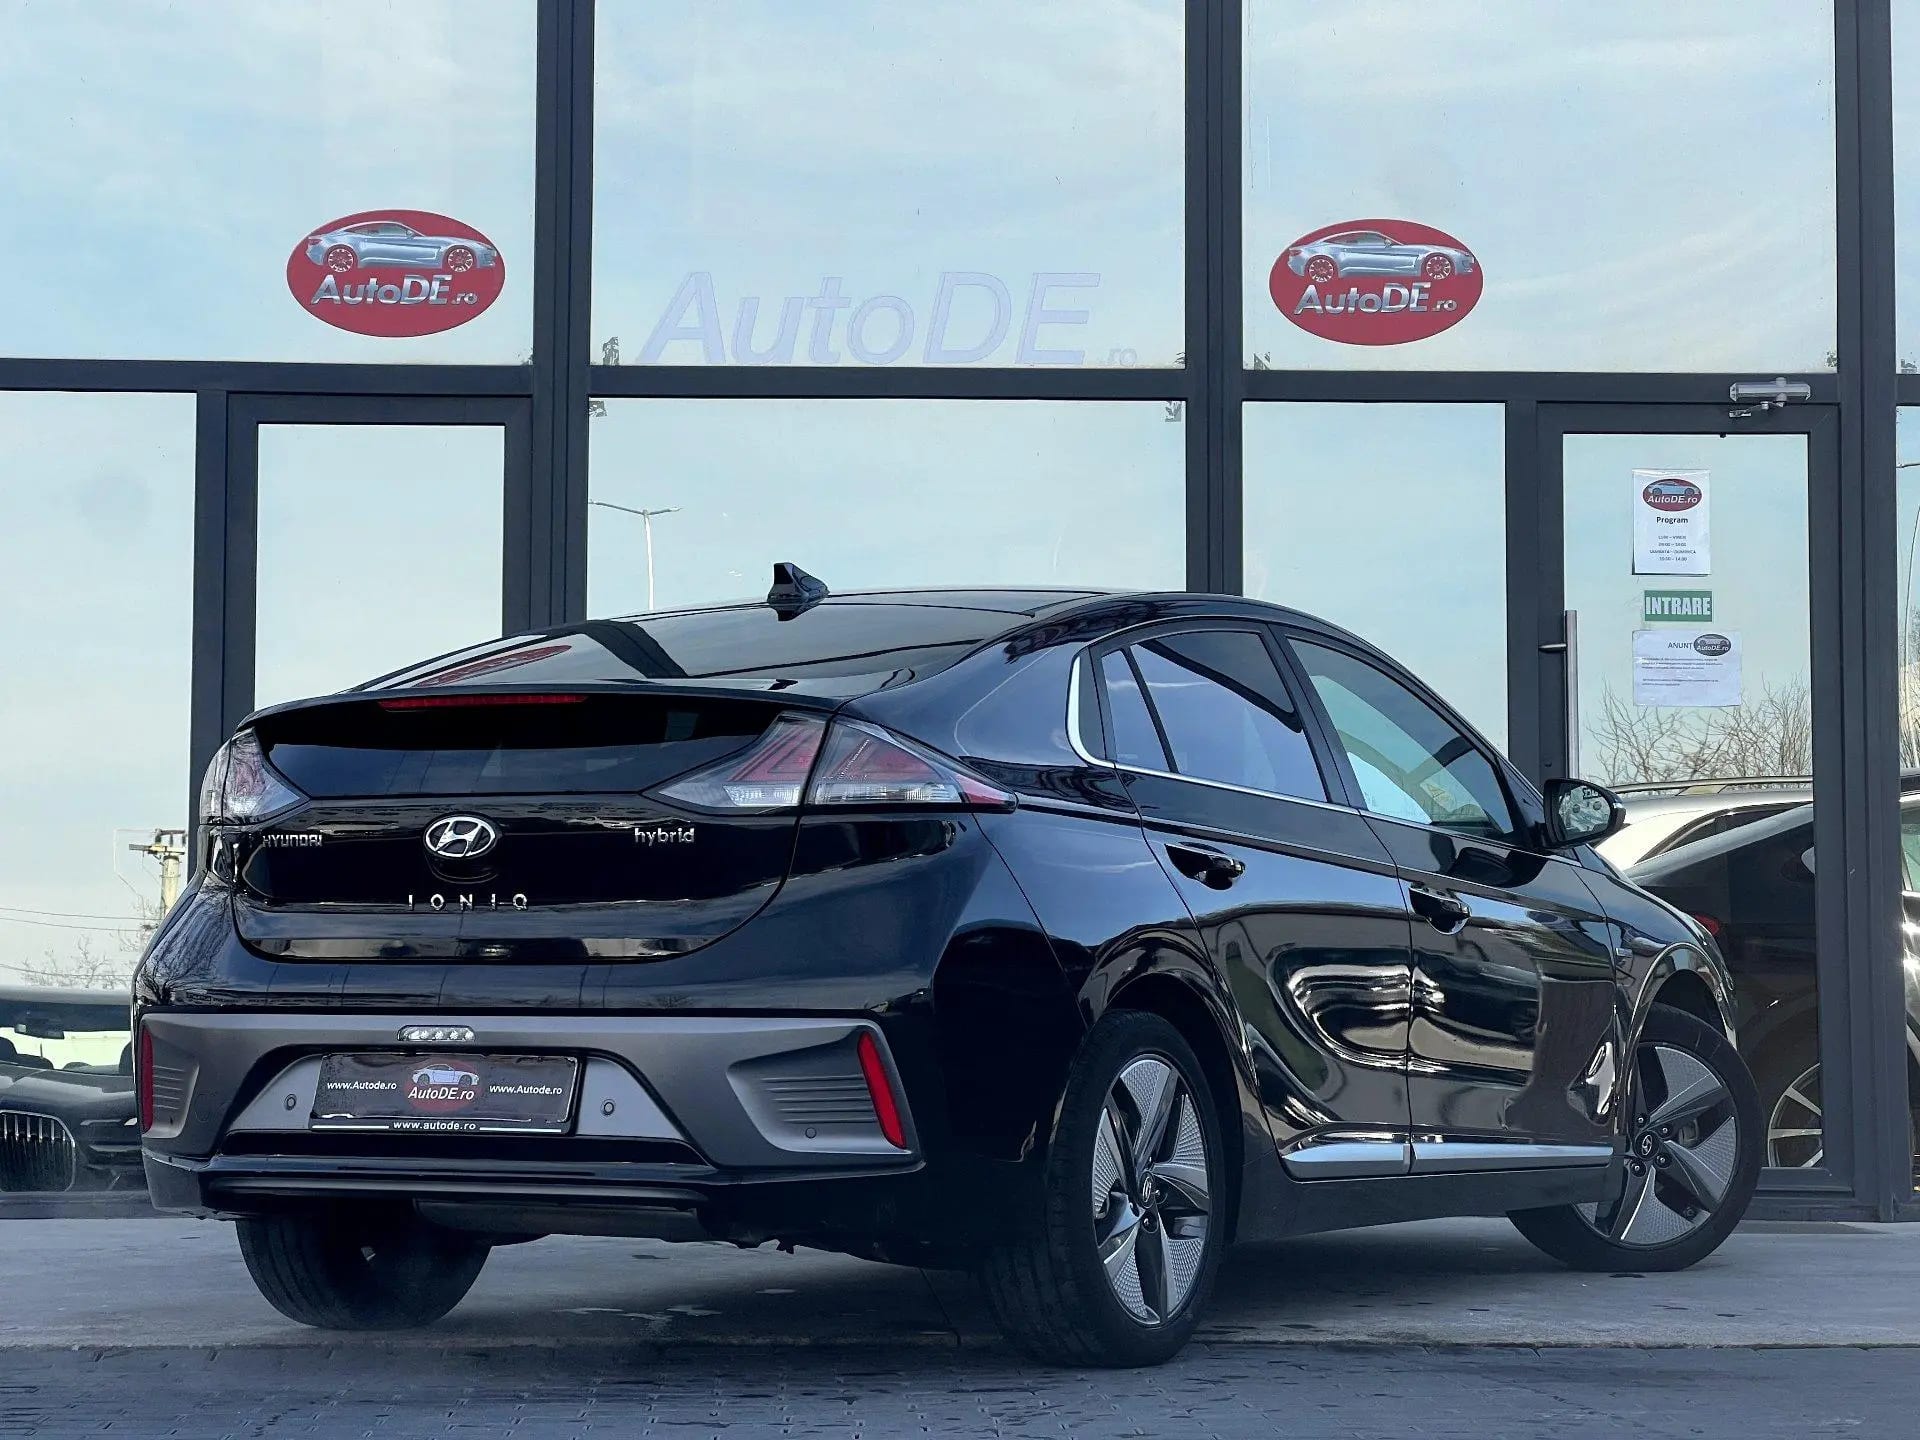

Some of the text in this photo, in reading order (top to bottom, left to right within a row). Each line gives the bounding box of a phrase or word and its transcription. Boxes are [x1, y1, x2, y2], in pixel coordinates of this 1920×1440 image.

[1656, 516, 1689, 524] Program
[1645, 597, 1711, 614] INTRARE
[262, 834, 323, 847] HYUNDAI
[634, 827, 695, 846] hybrid
[408, 893, 528, 910] IONIQ
[327, 1081, 397, 1090] www.Autode.ro
[489, 1085, 563, 1095] www.Autode.ro
[408, 1087, 474, 1100] AutoDE.ro
[393, 1121, 476, 1131] www.autode.ro
